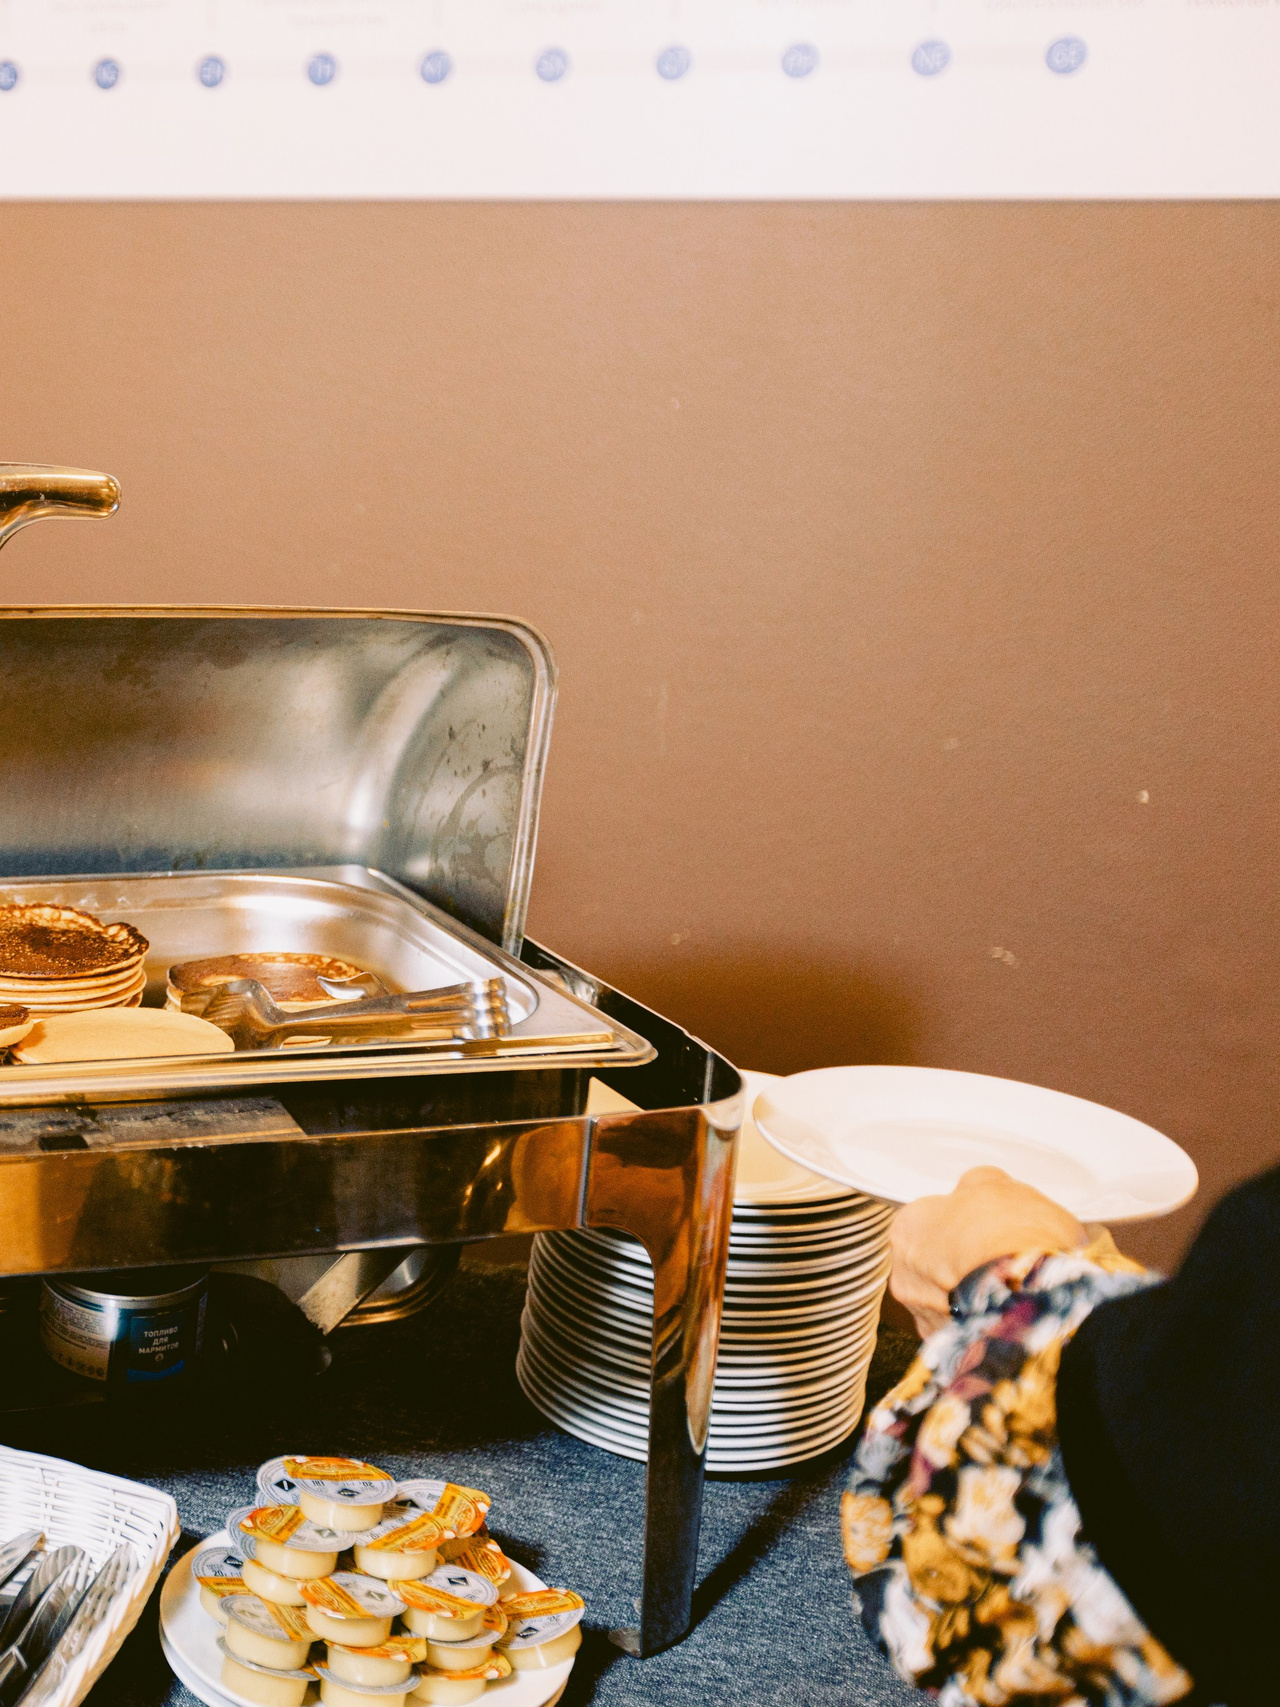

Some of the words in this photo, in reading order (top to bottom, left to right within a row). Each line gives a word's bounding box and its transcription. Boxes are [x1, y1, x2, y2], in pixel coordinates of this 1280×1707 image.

[144, 1326, 178, 1338] ТОПЛИВО
[152, 1336, 169, 1346] ДЛЯ
[138, 1342, 180, 1354] МАРМИТОВ
